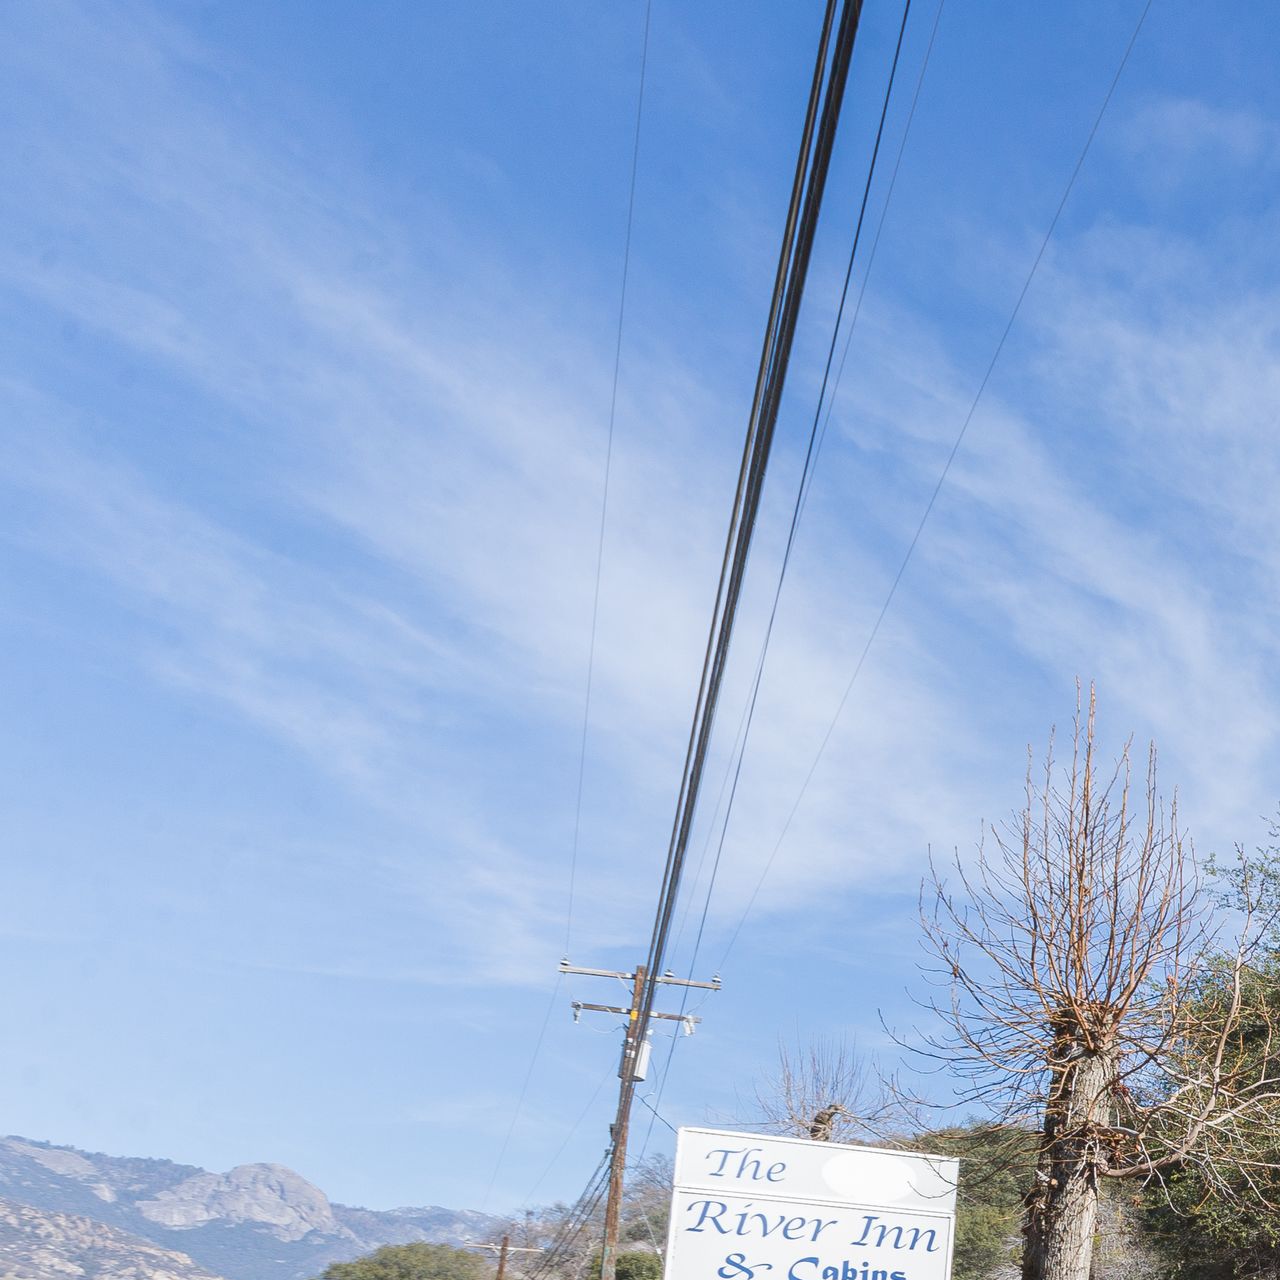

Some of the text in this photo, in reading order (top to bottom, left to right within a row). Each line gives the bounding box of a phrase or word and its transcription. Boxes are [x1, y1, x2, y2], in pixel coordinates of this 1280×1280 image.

[705, 1148, 787, 1182] The
[686, 1200, 940, 1252] River Inn
